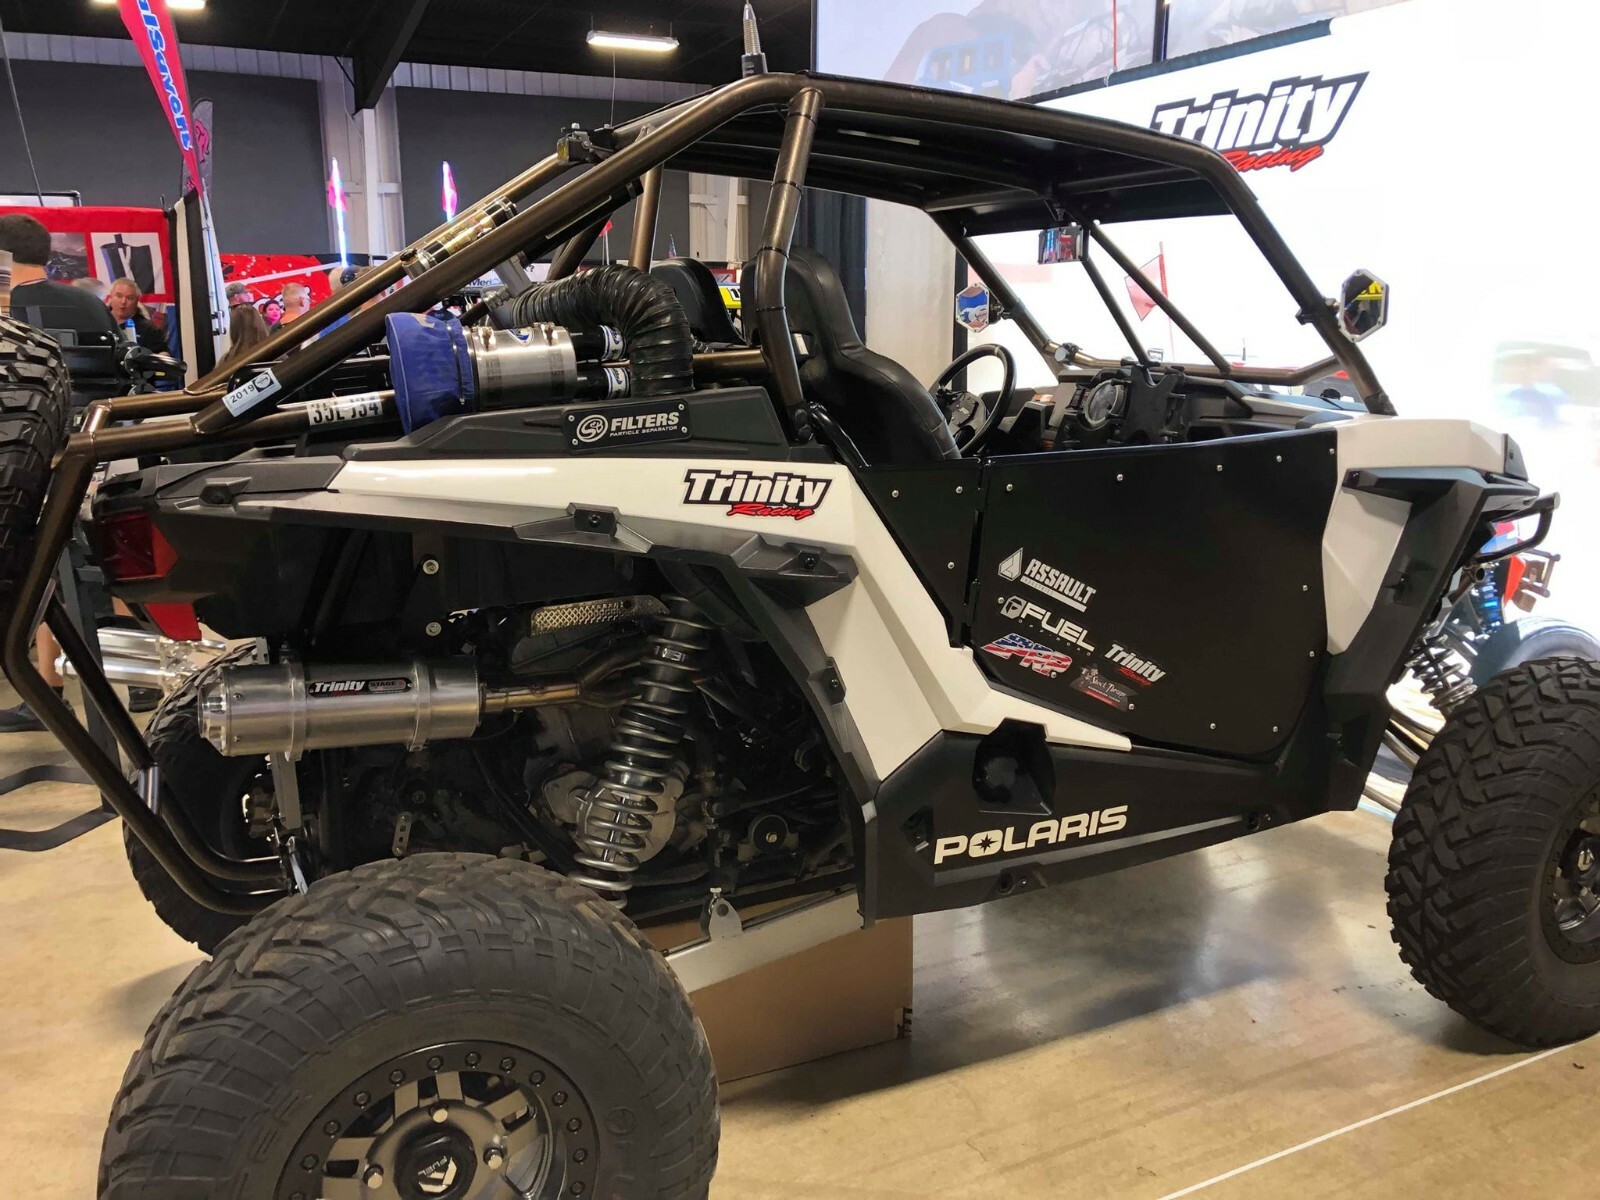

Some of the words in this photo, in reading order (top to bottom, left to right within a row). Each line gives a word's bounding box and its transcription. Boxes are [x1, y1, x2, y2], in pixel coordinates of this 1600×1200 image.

[1151, 73, 1367, 150] Trinity
[230, 384, 255, 403] 2019
[609, 429, 640, 437] PARTICLE
[641, 425, 678, 434] SEPARATOR
[610, 412, 680, 431] FILTERS
[685, 470, 831, 508] Trinity
[726, 503, 815, 520] Racing
[1024, 558, 1097, 604] ASSAULT
[1020, 602, 1095, 652] FUEL
[1104, 643, 1166, 683] Trinity
[314, 680, 366, 693] Trinity
[933, 805, 1128, 865] POLARIS
[417, 1155, 448, 1176] FUEL
